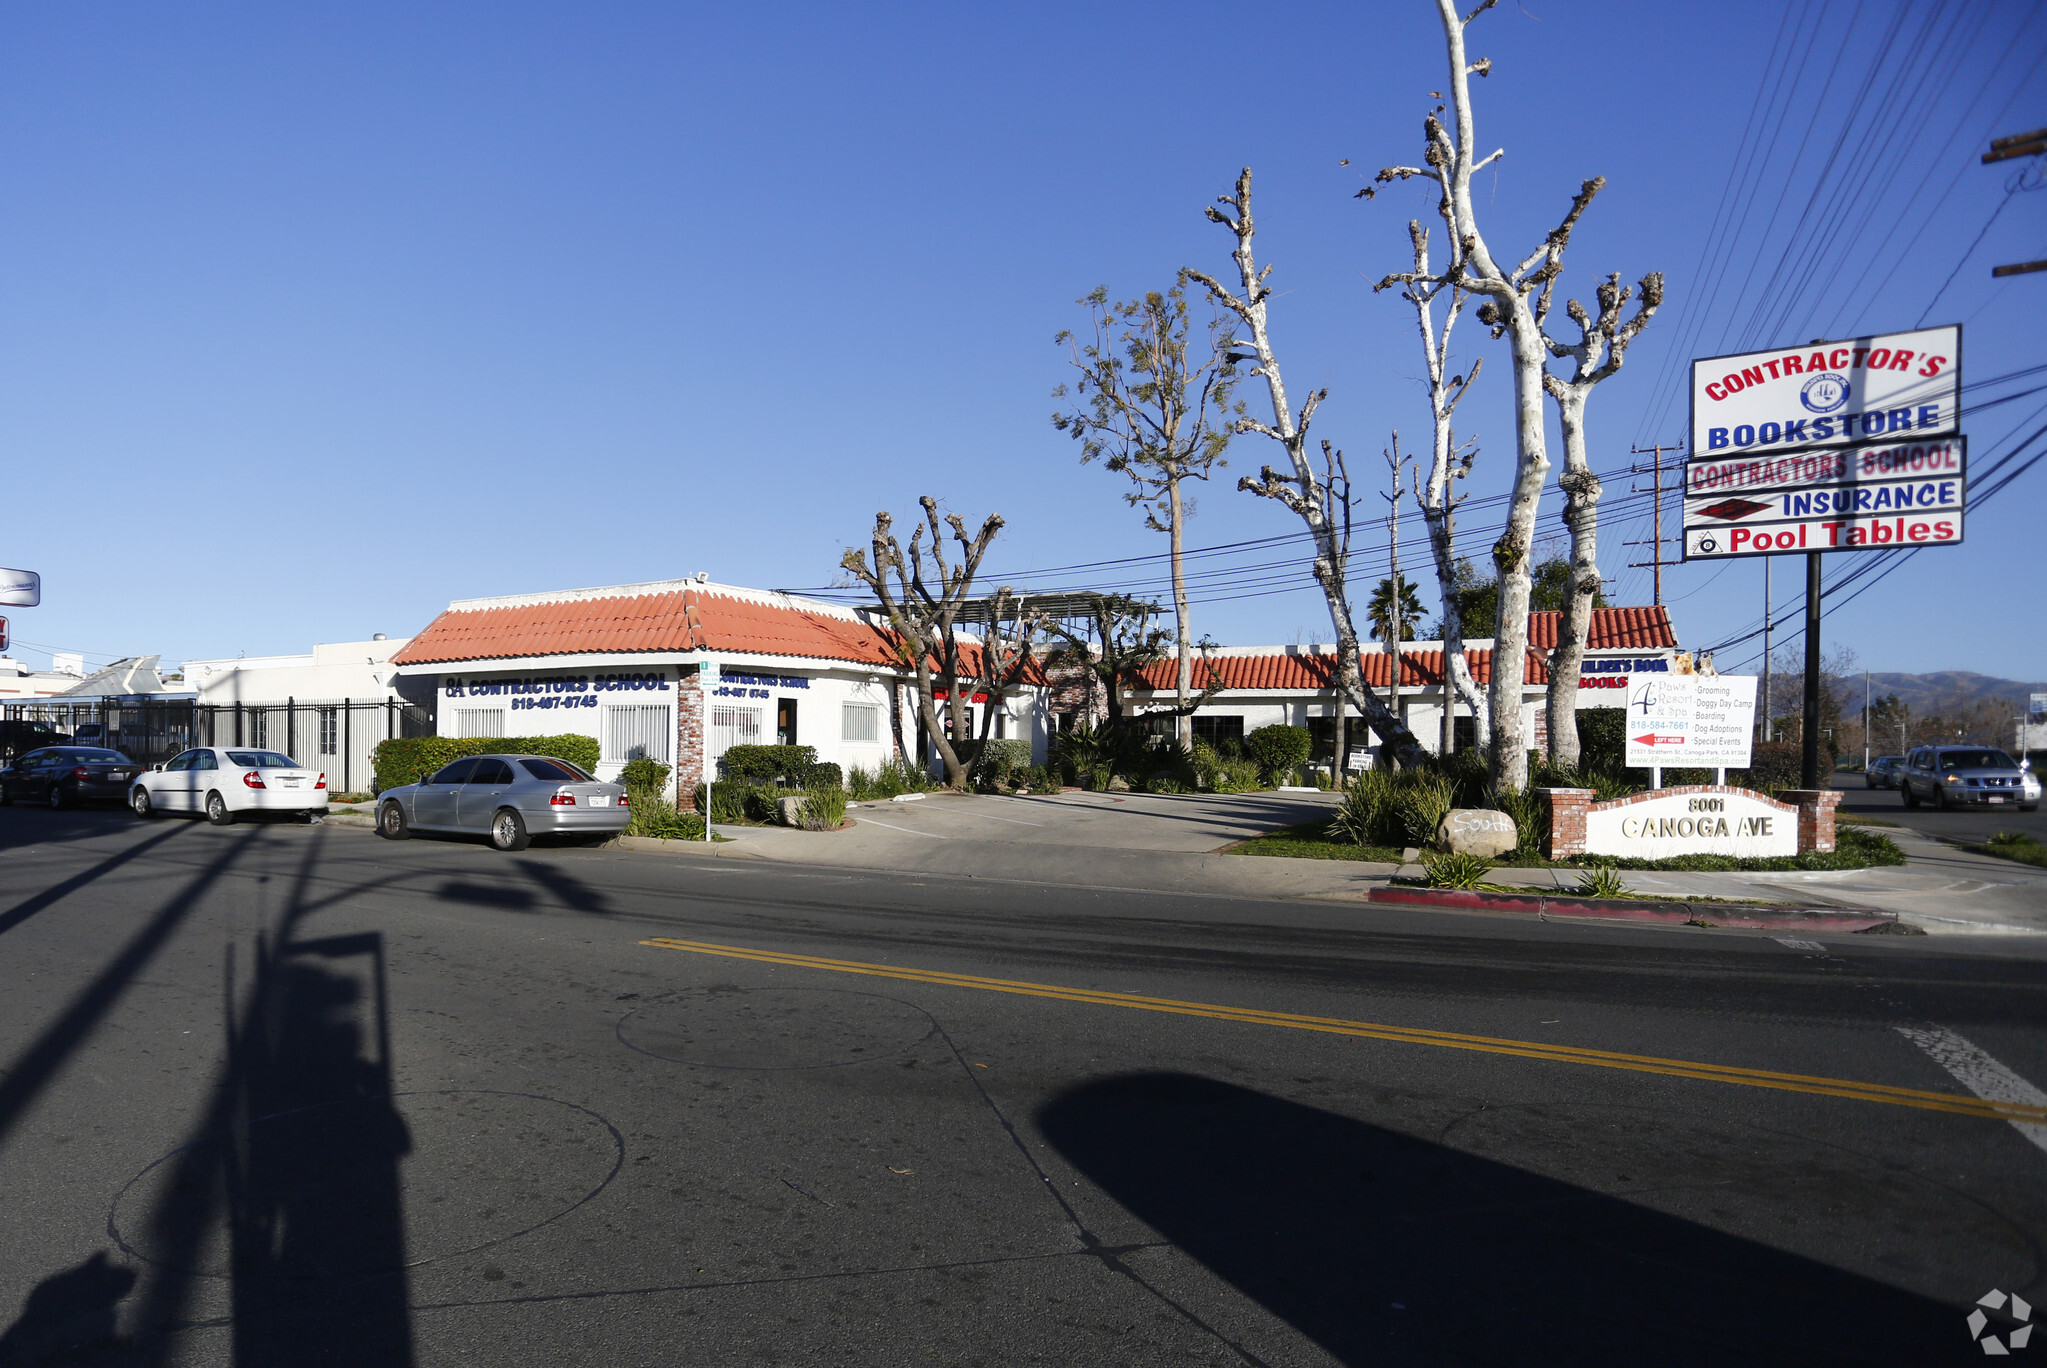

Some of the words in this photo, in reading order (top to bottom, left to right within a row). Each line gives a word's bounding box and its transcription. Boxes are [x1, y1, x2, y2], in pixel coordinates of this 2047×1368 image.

[1705, 347, 1947, 401] CONTRACTOR'S
[1709, 404, 1940, 450] BOOKSTORE
[1692, 454, 1847, 490] CONTRACTORS
[1863, 443, 1957, 475] SCHOOL
[1783, 481, 1956, 516] INSURANCE
[1730, 524, 1806, 552] Pool
[1822, 517, 1955, 547] Tables
[1581, 659, 1632, 673] UILDER'S
[1633, 658, 1668, 672] BOOK
[469, 675, 588, 696] CONTRACTORS
[593, 673, 671, 692] SCHOOL
[720, 670, 779, 687] ONTRACTORS
[1578, 676, 1629, 690] BOOKS
[1658, 681, 1687, 692] Paws
[1697, 685, 1731, 697] Grooming
[1631, 681, 1657, 715] 4
[1657, 693, 1693, 705] Resort
[1696, 698, 1718, 709] Doggy
[1720, 698, 1733, 709] Day
[1733, 699, 1753, 709] Camp
[1656, 706, 1665, 716] &
[1667, 706, 1688, 718] Spa
[1695, 711, 1726, 722] Boarding
[1630, 720, 1689, 730] 818-584-7661
[1694, 724, 1709, 735] Dog
[1709, 724, 1743, 734] Adoptions
[1693, 737, 1718, 747] Special
[1719, 737, 1741, 746] Events
[1684, 749, 1705, 757] Canoga
[1629, 757, 1748, 766] www.4PawsResortandSpa.com
[1688, 798, 1725, 813] 8001
[1621, 816, 1730, 838] CANOGA
[1737, 816, 1774, 837] AVE
